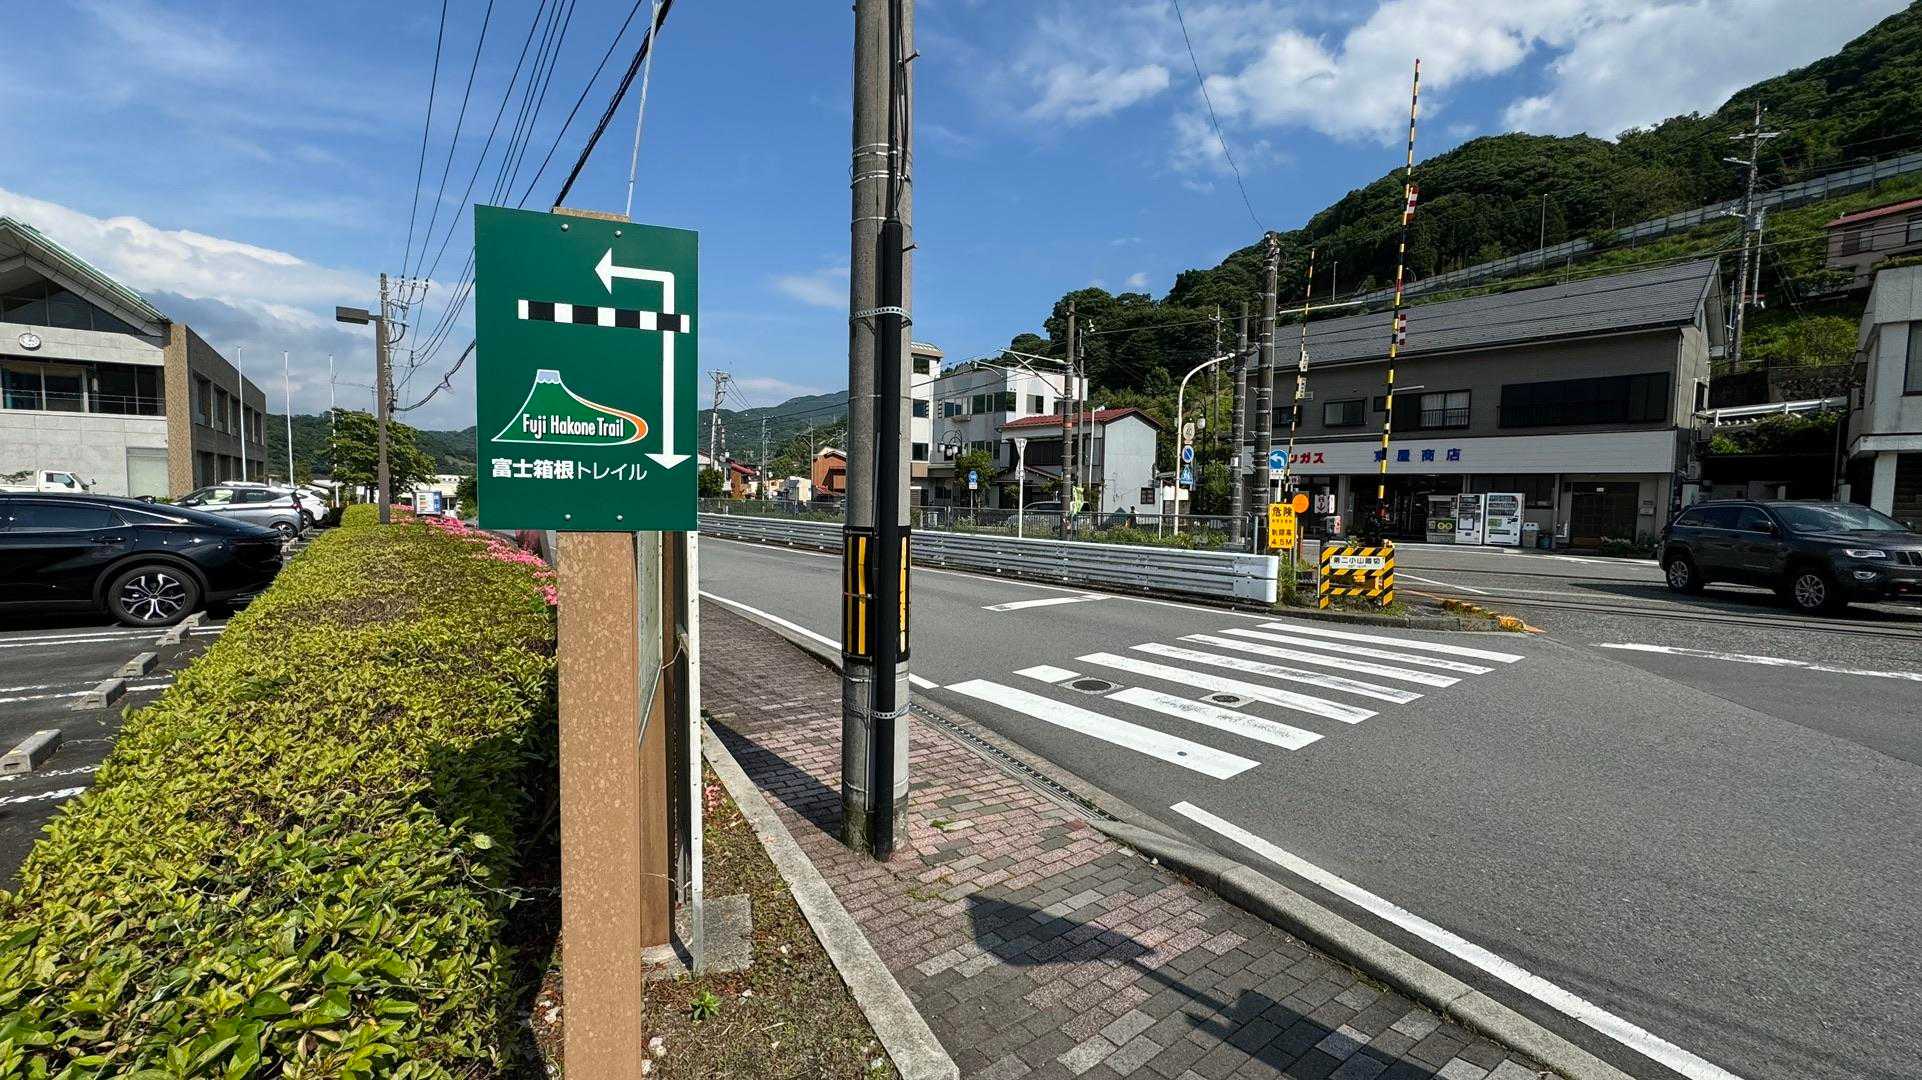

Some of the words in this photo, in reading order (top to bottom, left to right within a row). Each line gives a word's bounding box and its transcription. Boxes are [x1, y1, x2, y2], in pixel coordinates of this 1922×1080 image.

[522, 414, 546, 439] Fuji
[550, 415, 595, 436] Hakone
[597, 417, 624, 437] Trail
[491, 457, 648, 481] 富士箱根トレイル
[1272, 506, 1292, 517] 危険
